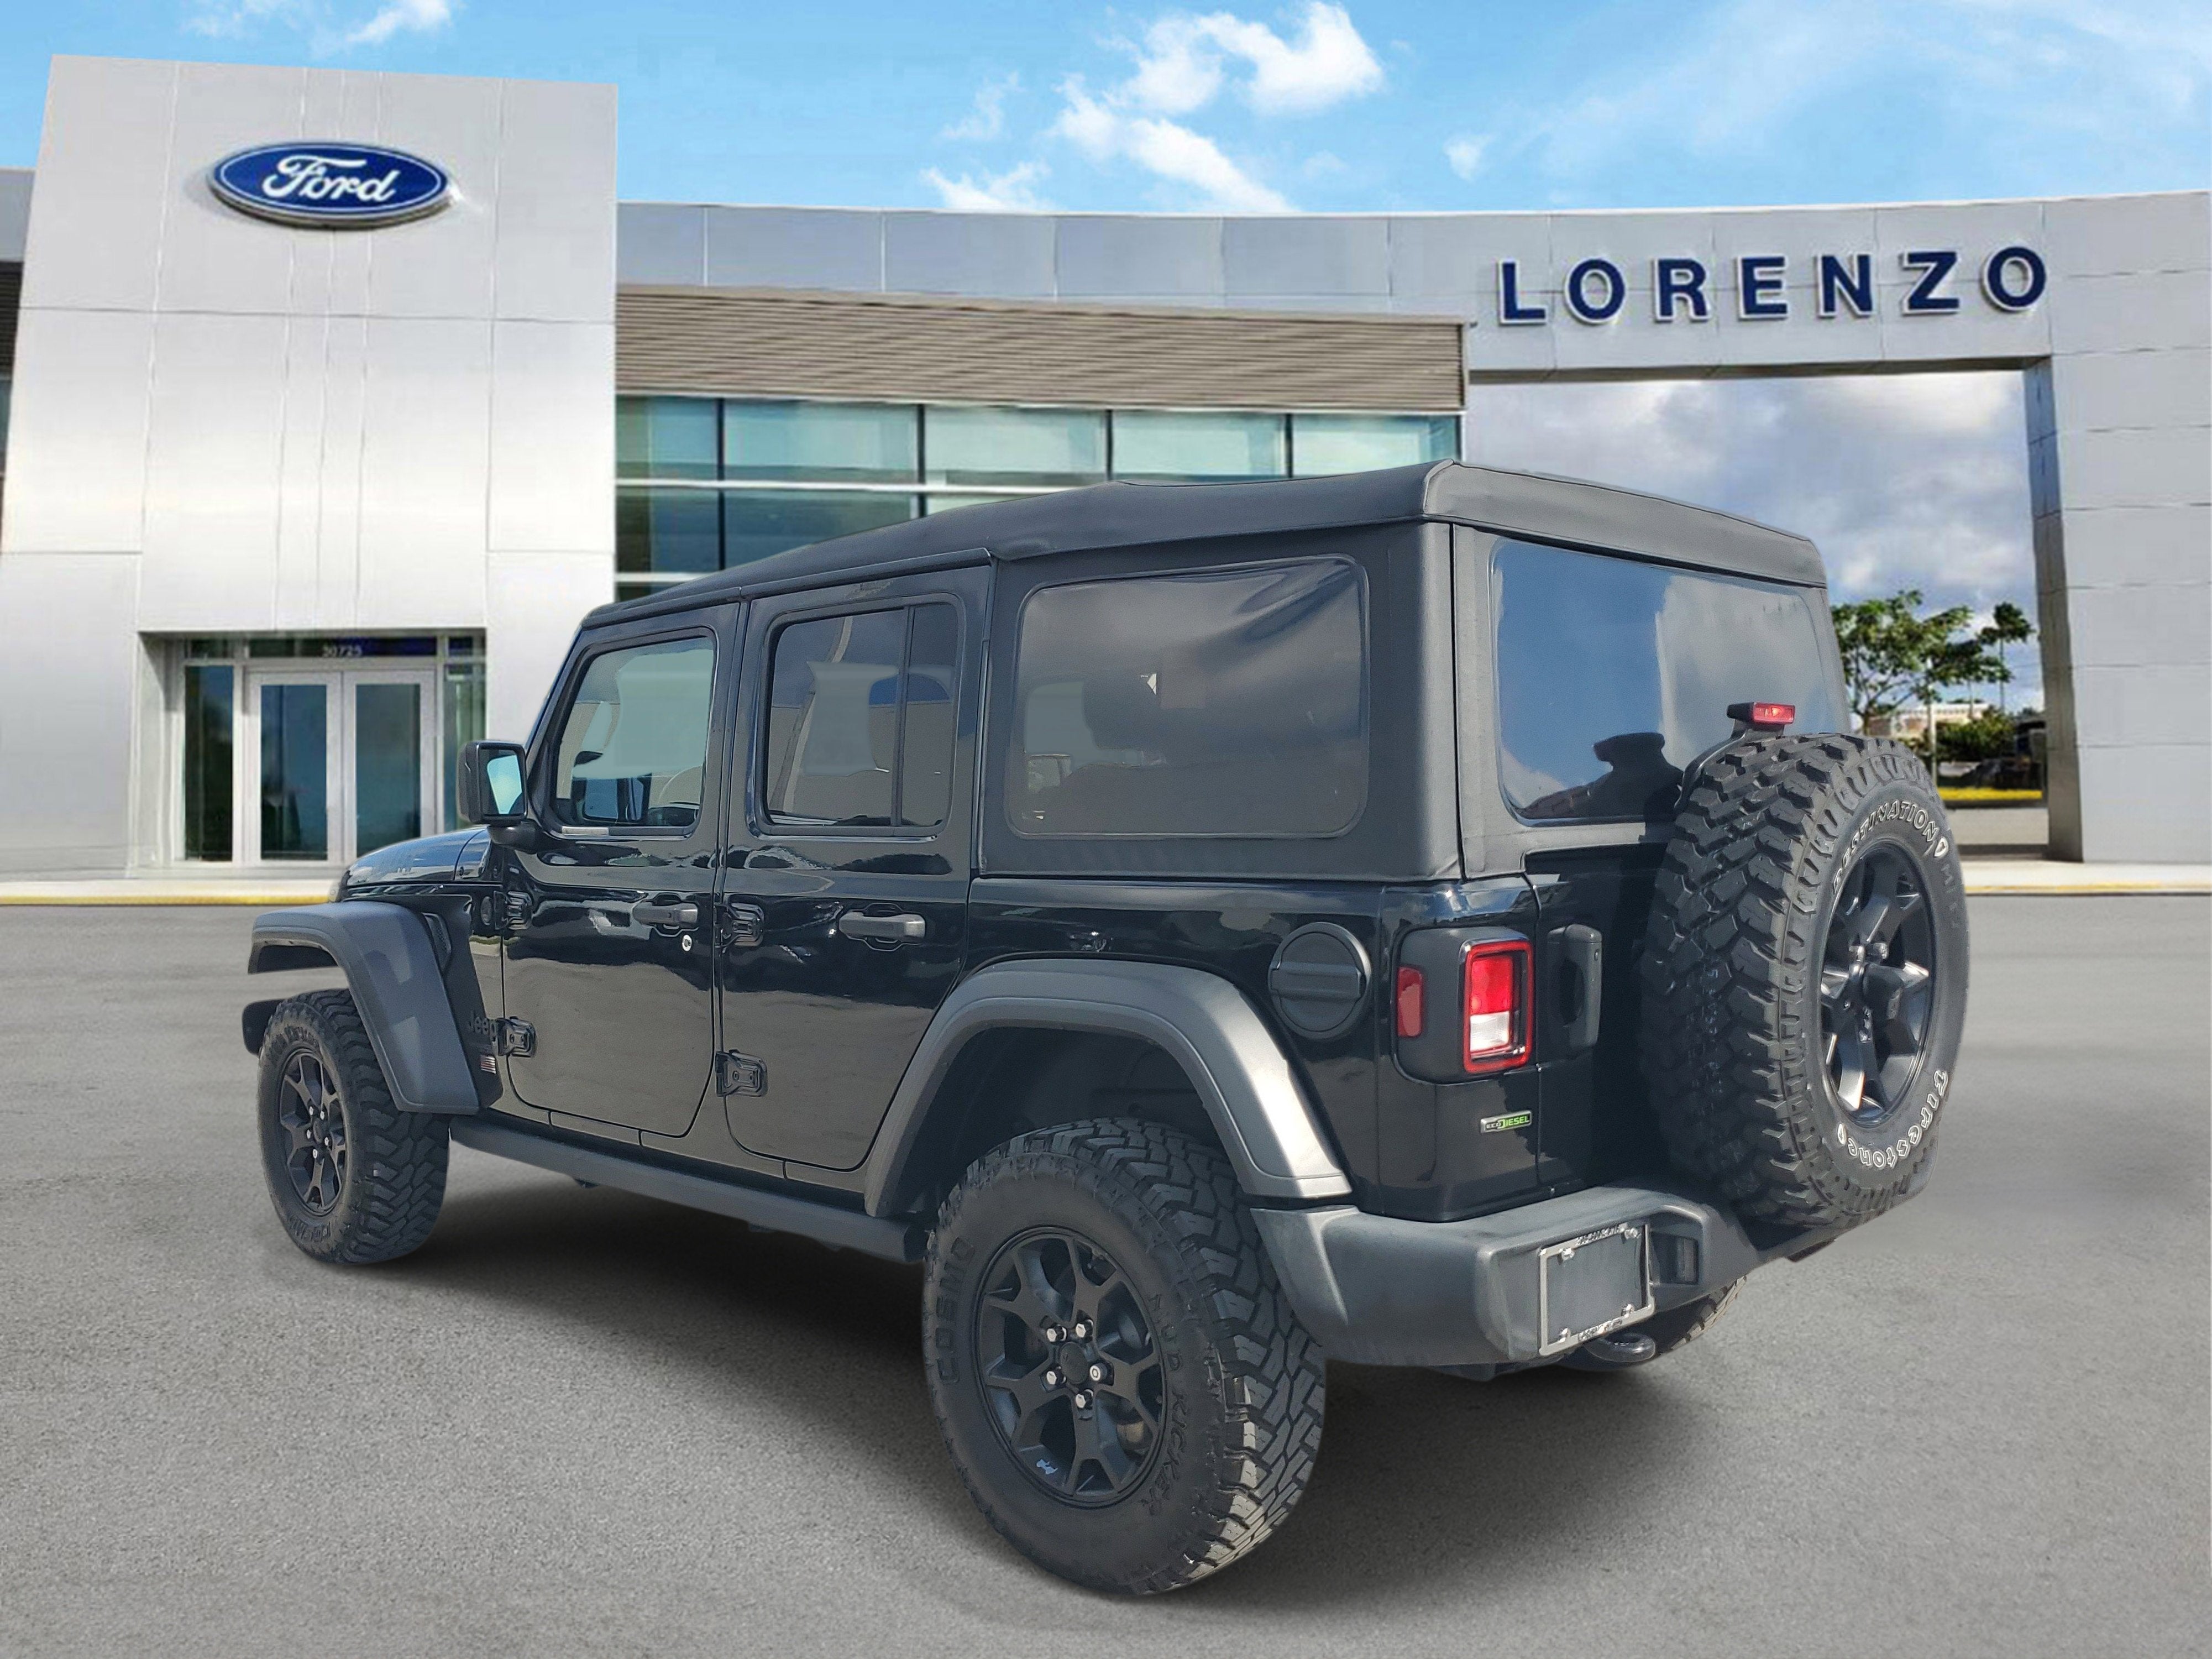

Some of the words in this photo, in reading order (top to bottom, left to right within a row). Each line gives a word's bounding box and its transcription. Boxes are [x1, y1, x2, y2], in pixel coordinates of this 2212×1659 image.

[262, 154, 400, 202] Ford
[1499, 246, 2047, 323] LORENZO
[467, 1010, 497, 1042] Jeep
[1848, 1069, 1949, 1169] Firestone
[935, 1236, 976, 1383] COSMO
